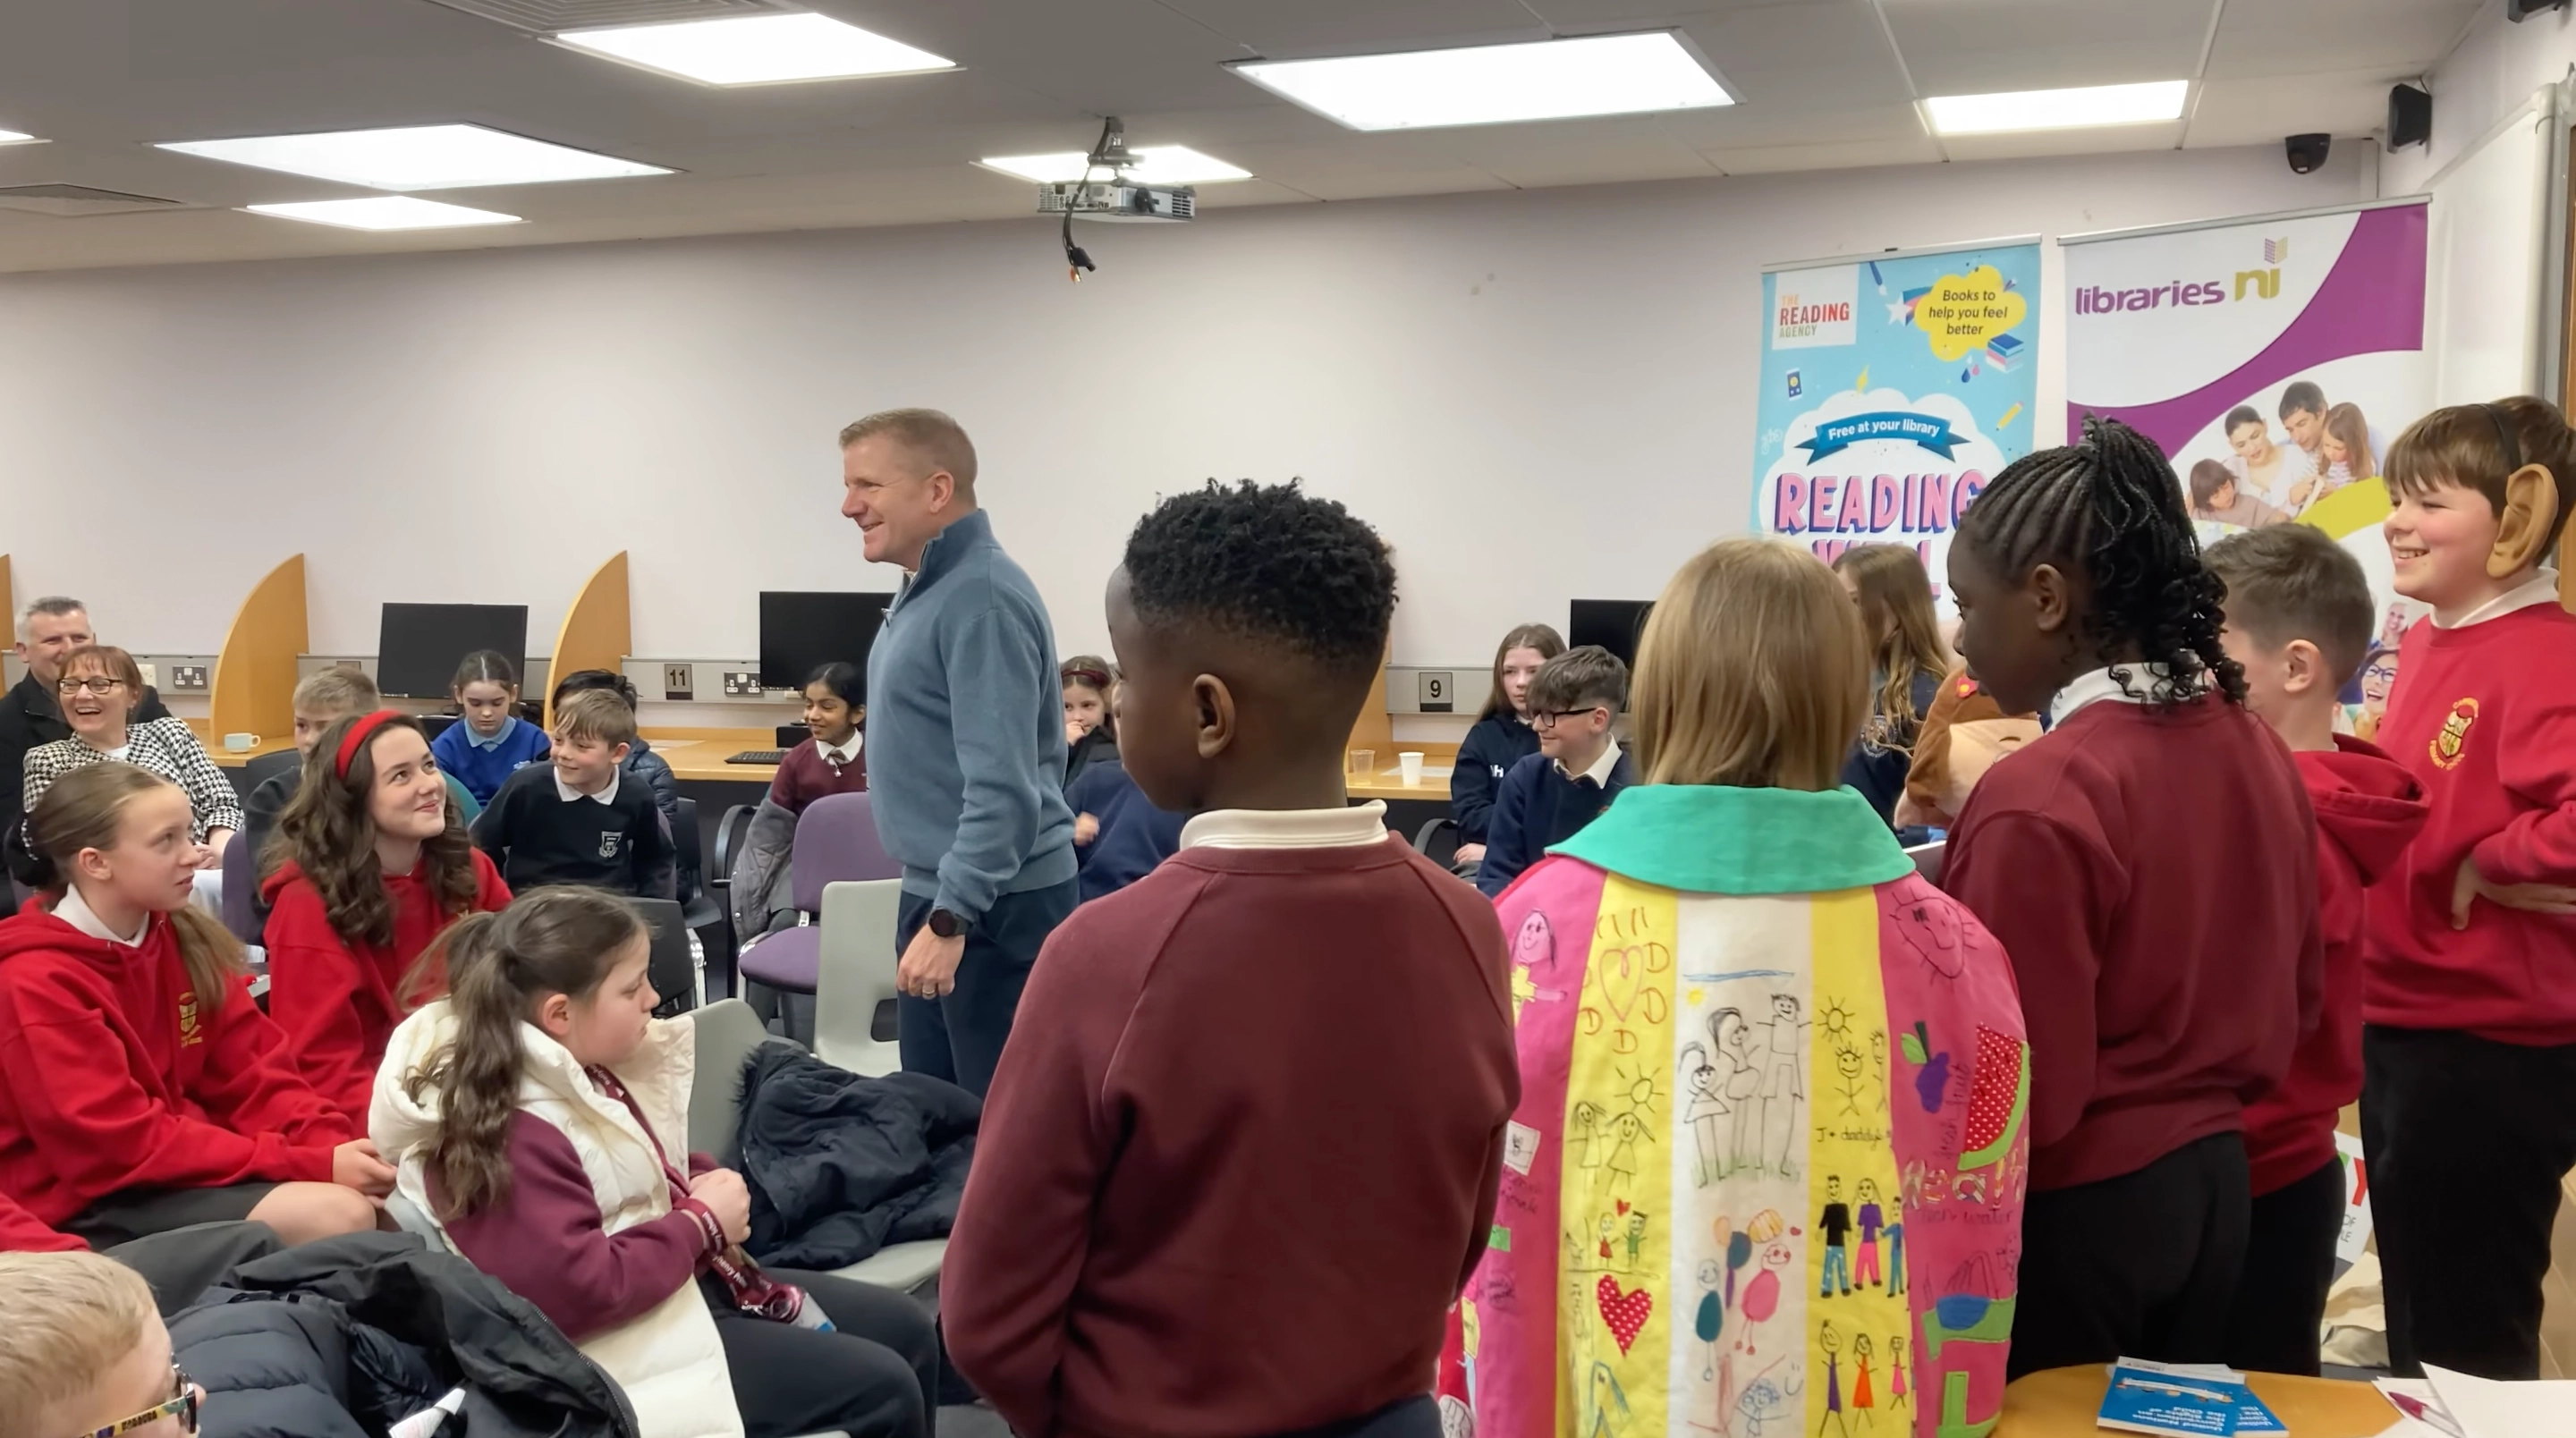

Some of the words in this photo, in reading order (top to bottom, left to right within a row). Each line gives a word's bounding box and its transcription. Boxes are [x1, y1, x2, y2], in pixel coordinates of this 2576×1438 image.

[1781, 293, 1799, 307] THE
[1943, 289, 1979, 301] Books
[1983, 290, 1996, 301] to
[2075, 279, 2225, 315] libraries
[2234, 267, 2281, 302] ni
[1779, 301, 1850, 326] READING
[1928, 305, 1955, 320] help
[1957, 309, 1979, 320] you
[1983, 305, 2008, 318] feel
[1778, 325, 1818, 338] AGENCY
[1946, 323, 1984, 335] better
[1828, 426, 1856, 441] Free
[1857, 420, 1870, 433] at
[1872, 420, 1901, 434] your
[1902, 419, 1940, 438] library
[1775, 469, 1988, 535] READING
[669, 669, 686, 687] 11
[1429, 679, 1442, 698] 9
